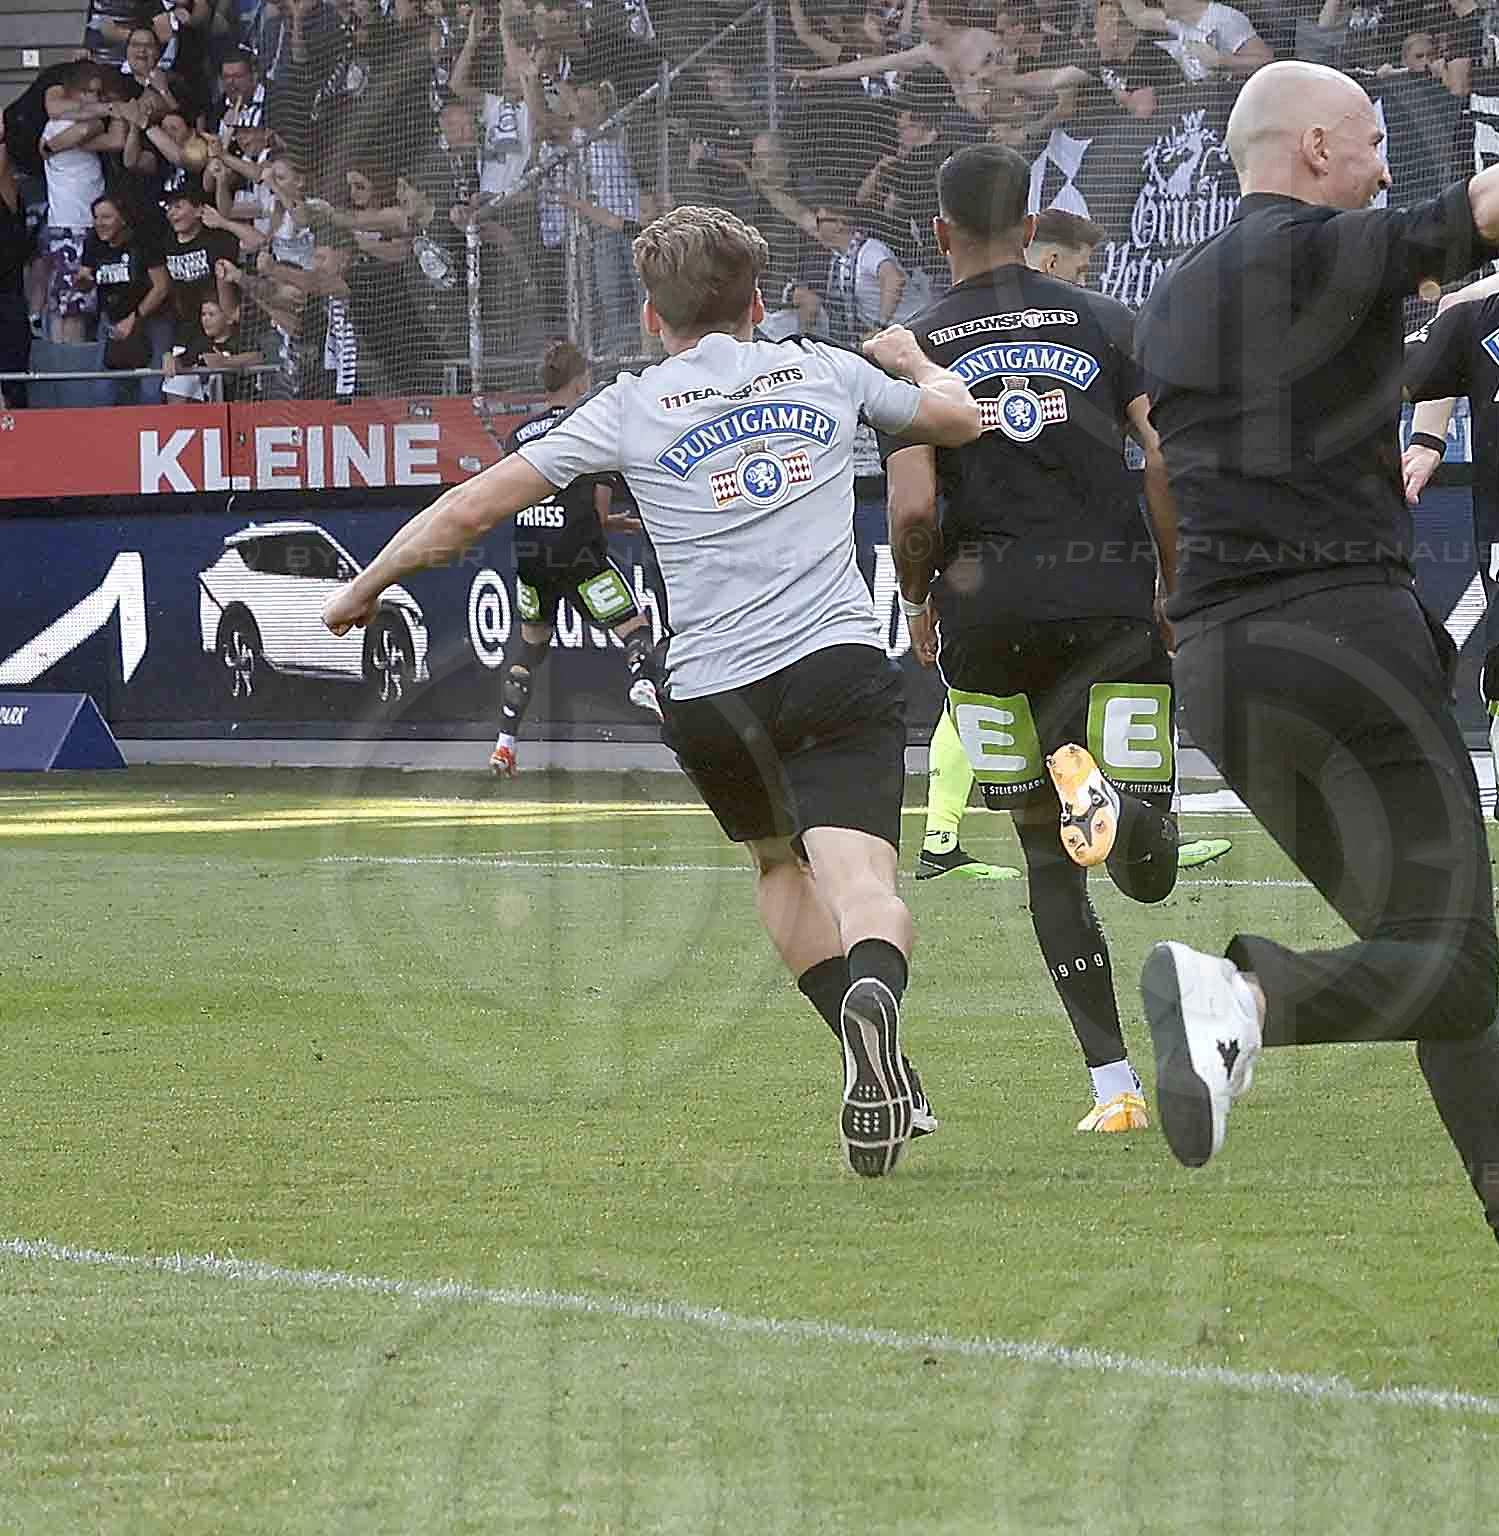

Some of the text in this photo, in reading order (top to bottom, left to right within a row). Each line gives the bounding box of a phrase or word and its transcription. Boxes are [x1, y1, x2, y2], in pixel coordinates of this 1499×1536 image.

[952, 348, 1090, 383] UNTIGAMER
[139, 424, 441, 494] KLEINE
[664, 406, 831, 472] PUNTIGAMER
[1051, 953, 1104, 981] 1909
